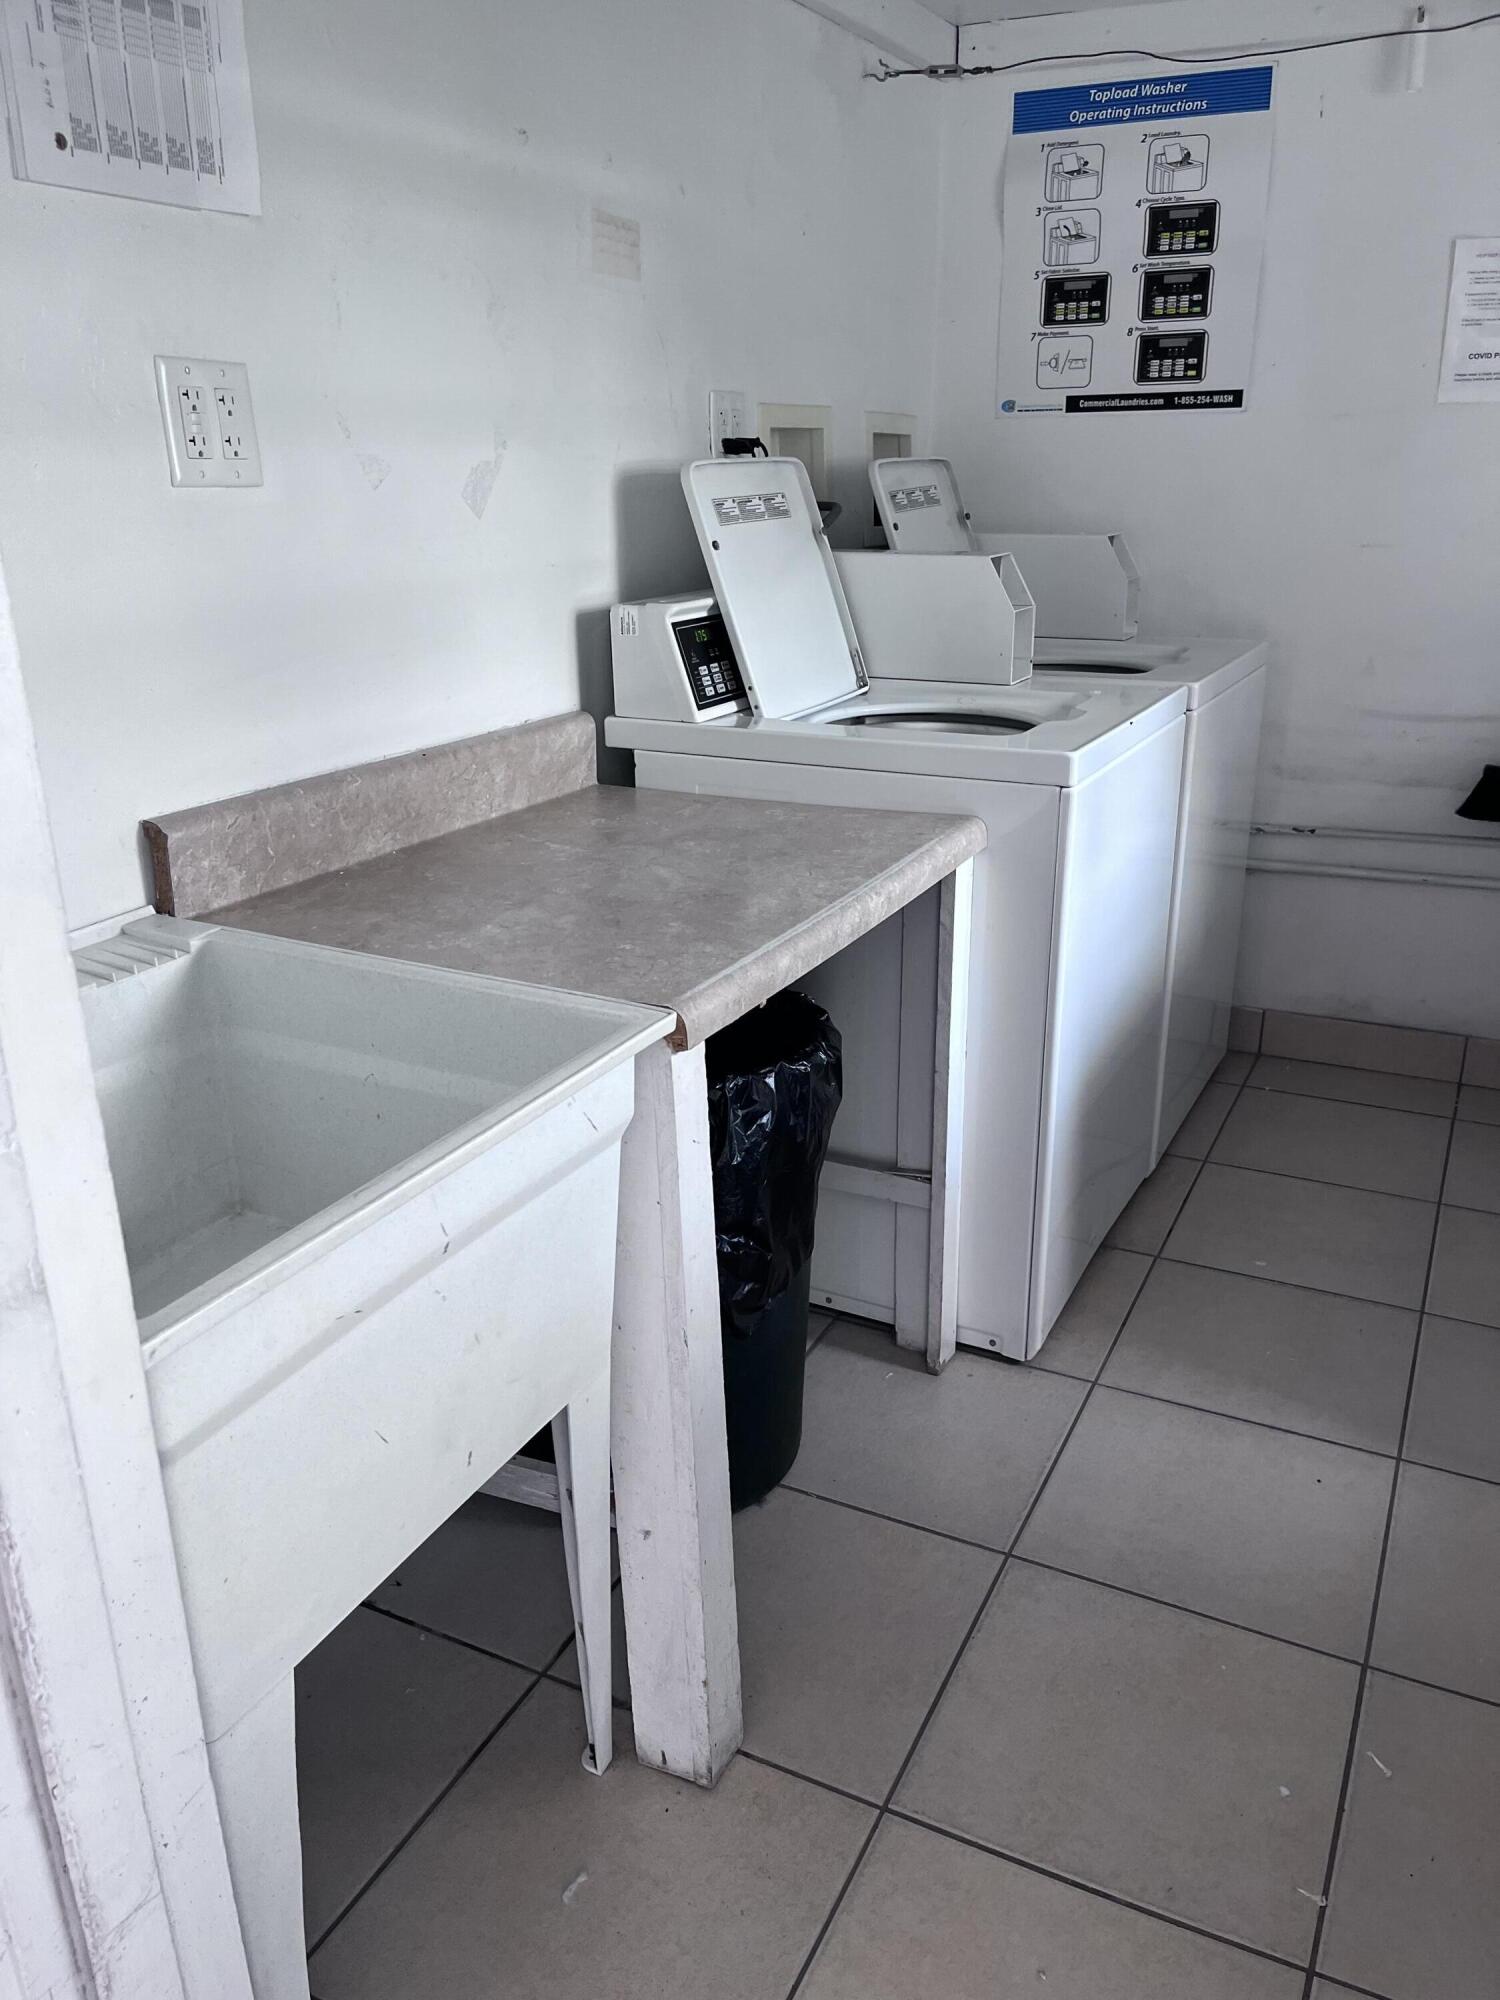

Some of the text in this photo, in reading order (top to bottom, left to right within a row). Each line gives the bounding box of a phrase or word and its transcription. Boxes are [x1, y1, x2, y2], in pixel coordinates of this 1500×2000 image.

[1089, 82, 1188, 103] Topload Washer
[1069, 99, 1208, 124] Operating Instructions
[1141, 134, 1148, 143] 2
[1041, 143, 1045, 153] 1
[1135, 199, 1142, 208] 4
[1036, 207, 1042, 217] 3
[1132, 263, 1139, 273] 6
[1033, 270, 1040, 280] 5
[1030, 332, 1037, 341] 7
[1127, 327, 1134, 337] 8
[1468, 352, 1492, 360] COVID
[1079, 394, 1234, 408] CommercialLaundries.com 1-855-254-WASH
